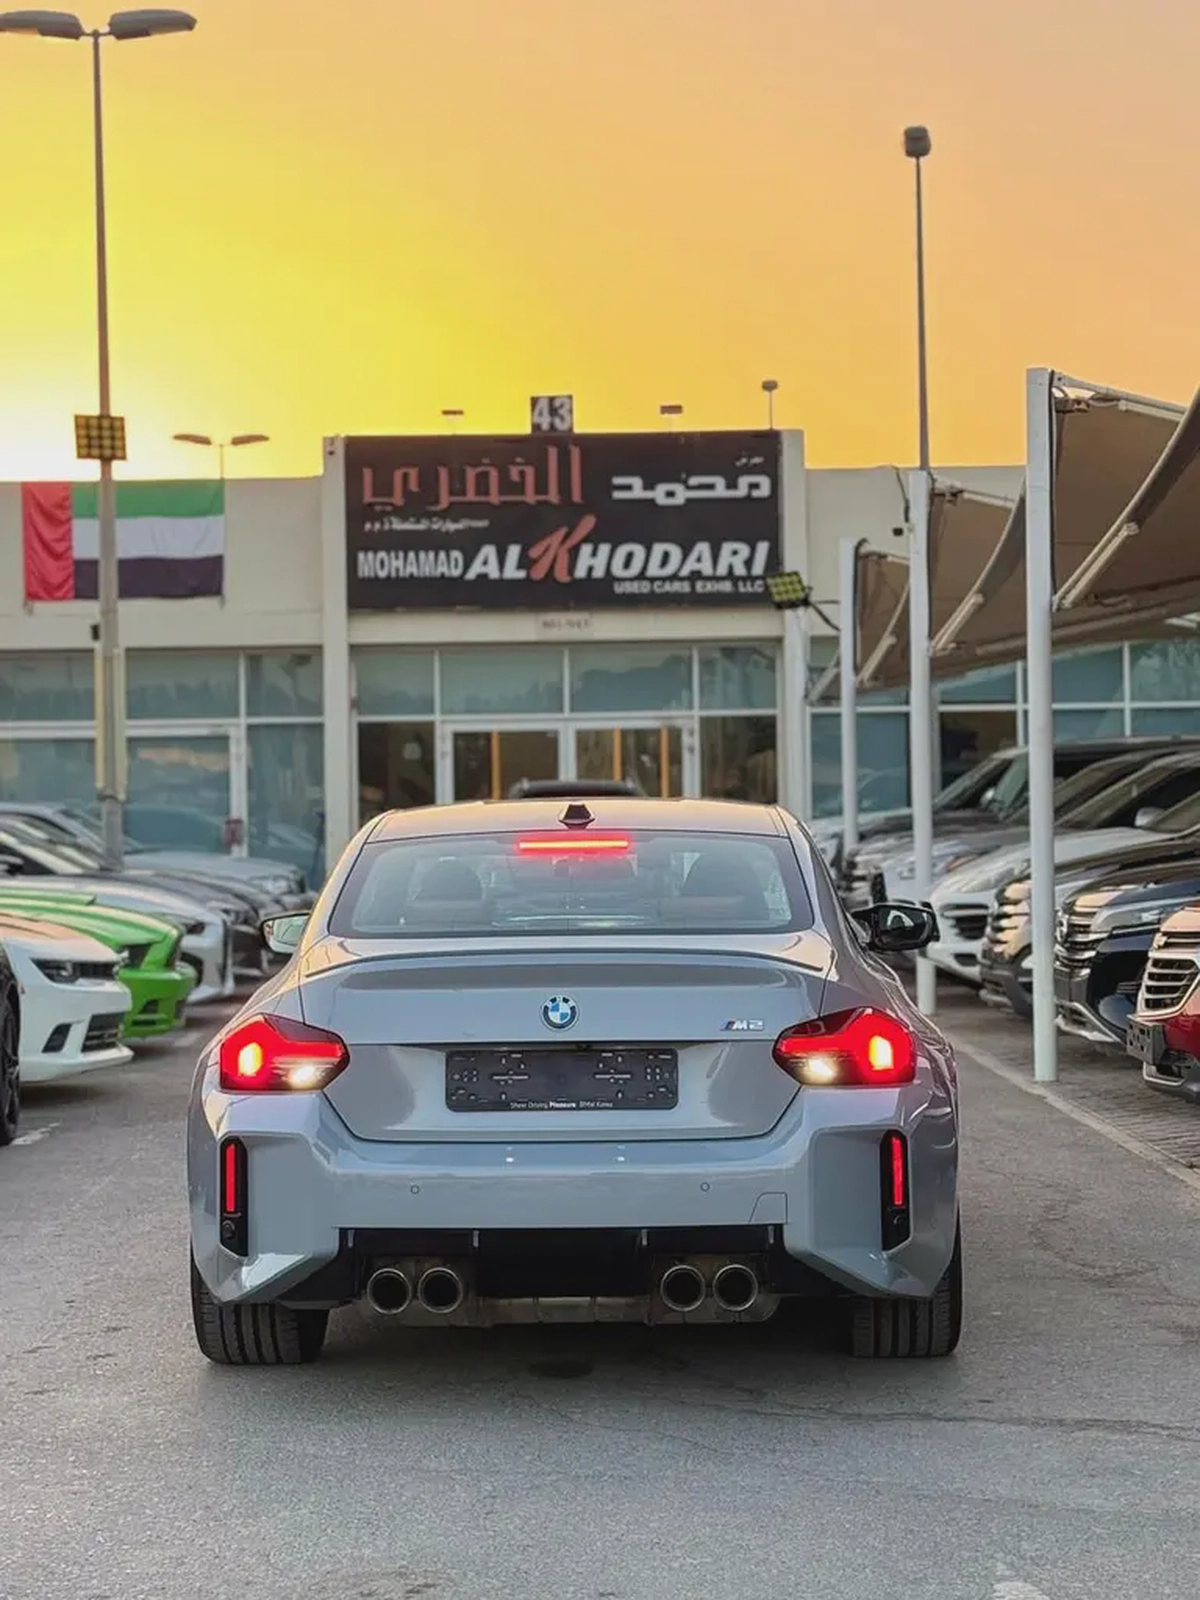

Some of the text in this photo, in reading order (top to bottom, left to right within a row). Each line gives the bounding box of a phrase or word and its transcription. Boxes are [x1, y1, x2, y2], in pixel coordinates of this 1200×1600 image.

[532, 396, 571, 431] 43
[362, 444, 771, 511] محمد الخضري
[357, 550, 464, 579] MOHAMAD
[613, 580, 650, 594] USED
[653, 579, 691, 593] CARS
[738, 578, 765, 592] LLC
